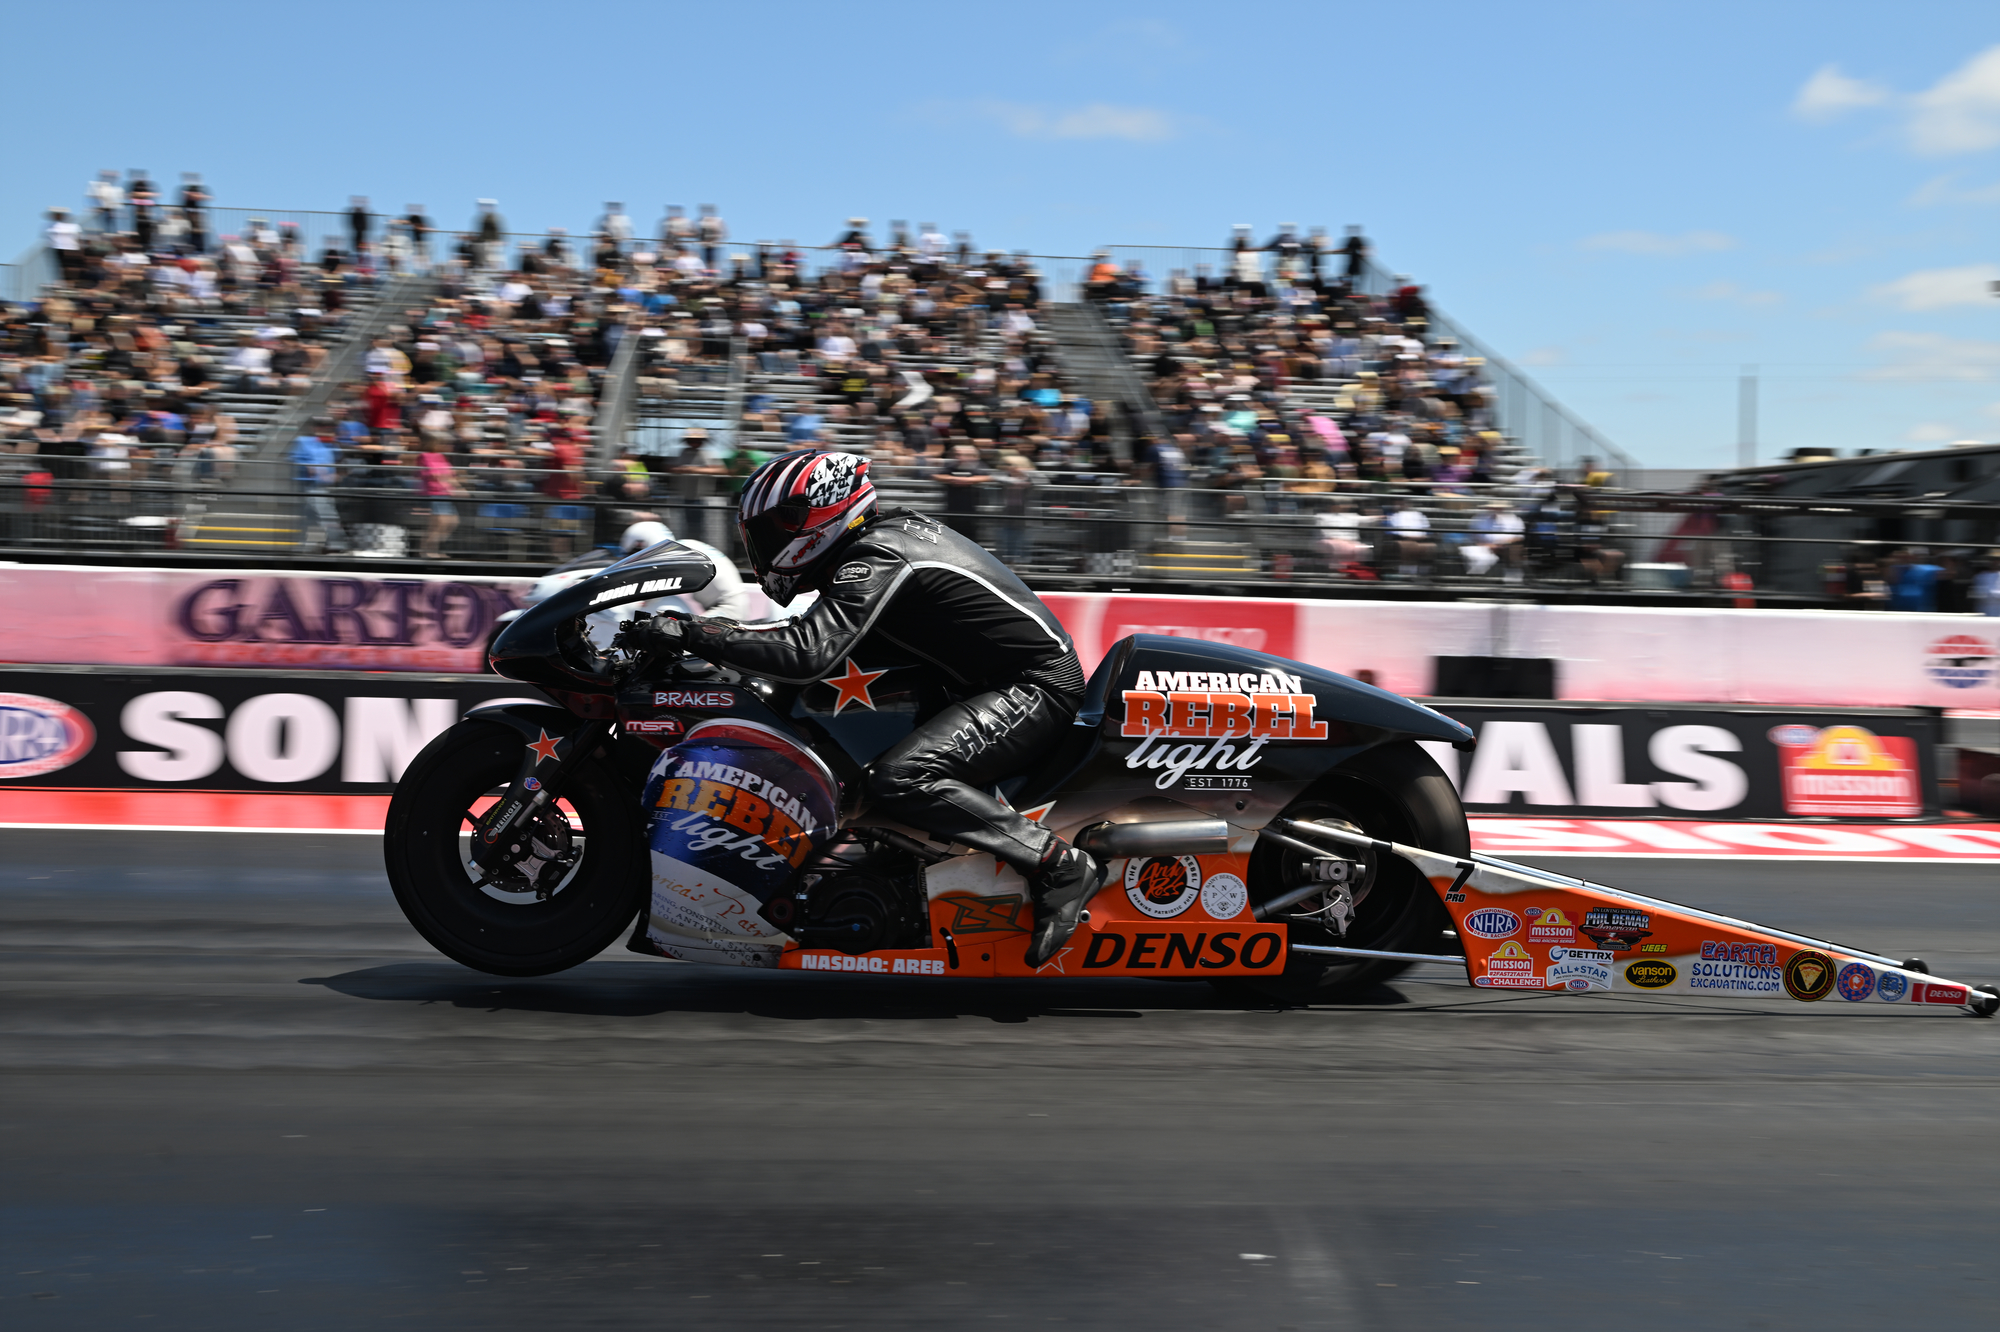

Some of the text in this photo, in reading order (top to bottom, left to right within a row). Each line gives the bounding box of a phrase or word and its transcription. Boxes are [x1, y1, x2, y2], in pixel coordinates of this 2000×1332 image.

[589, 577, 683, 605] JOHN HALL
[1135, 671, 1303, 694] AMERICAN
[654, 691, 735, 707] BRAKES
[952, 683, 1042, 762] HALL
[1121, 690, 1329, 740] REBEL
[626, 721, 675, 731] MSR
[116, 690, 459, 785] SON
[1125, 728, 1271, 790] light
[1461, 720, 1749, 812] ALS
[1189, 778, 1249, 788] EST 1776
[675, 761, 818, 832] AMERICAN
[670, 810, 787, 871] light
[1128, 865, 1137, 882] THE
[1134, 857, 1187, 889] Andy
[1184, 856, 1198, 882] REBEL
[1447, 861, 1475, 892] 7
[652, 874, 705, 902] erica's
[1145, 877, 1185, 902] Ross
[1132, 893, 1152, 912] BURNING
[1154, 905, 1182, 914] PATRIOTIC
[1444, 893, 1466, 903] PRO
[1474, 908, 1513, 917] CHAMPIONSHIP
[1585, 912, 1650, 929] PHIL DEMAR
[1473, 914, 1513, 933] NHRA
[1592, 922, 1638, 931] American
[1473, 930, 1488, 938] DRAG
[1081, 932, 1282, 969] DENSO
[1568, 950, 1613, 960] GETTRX
[1641, 944, 1667, 953] JEGS
[1700, 940, 1776, 965] EARTH
[1796, 951, 1829, 964] ONE BITE
[801, 954, 945, 975] NASDAQ: AREB
[1553, 966, 1608, 980] ALL STAR
[1632, 966, 1672, 976] vanson
[1692, 963, 1781, 980] SOLUTIONS
[1493, 978, 1541, 986] CHALLENGE
[1570, 980, 1588, 988] NHRA
[1690, 977, 1780, 992] EXCAVATING.COM
[1929, 989, 1962, 999] DENSO
